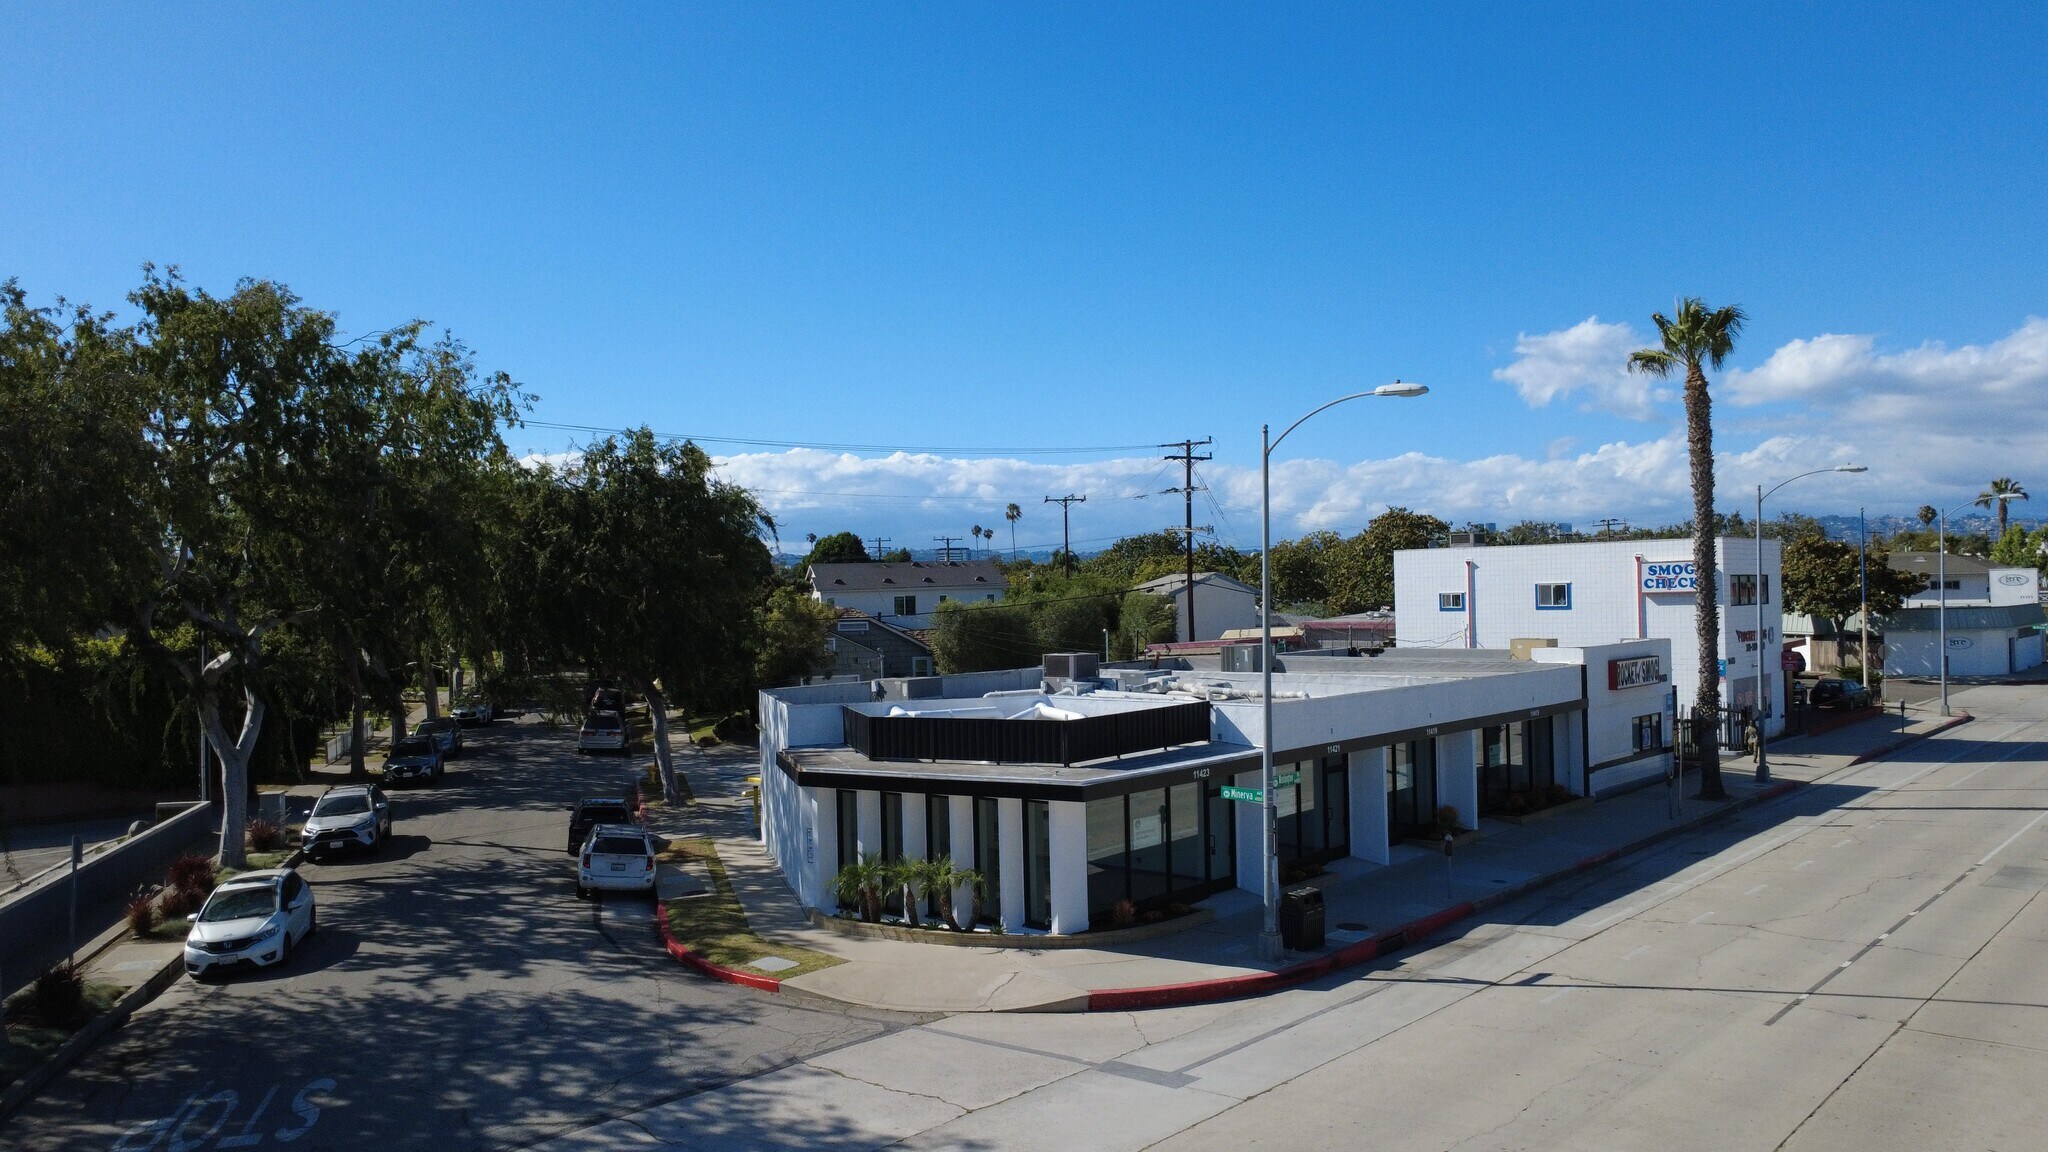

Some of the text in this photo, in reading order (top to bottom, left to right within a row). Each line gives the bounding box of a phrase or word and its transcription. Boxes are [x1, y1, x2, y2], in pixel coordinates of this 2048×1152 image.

[1648, 564, 1696, 576] SMOG
[1643, 577, 1697, 589] CHECK
[1193, 768, 1211, 780] 11423
[1230, 788, 1253, 801] Minerva
[111, 1078, 338, 1152] STOP
